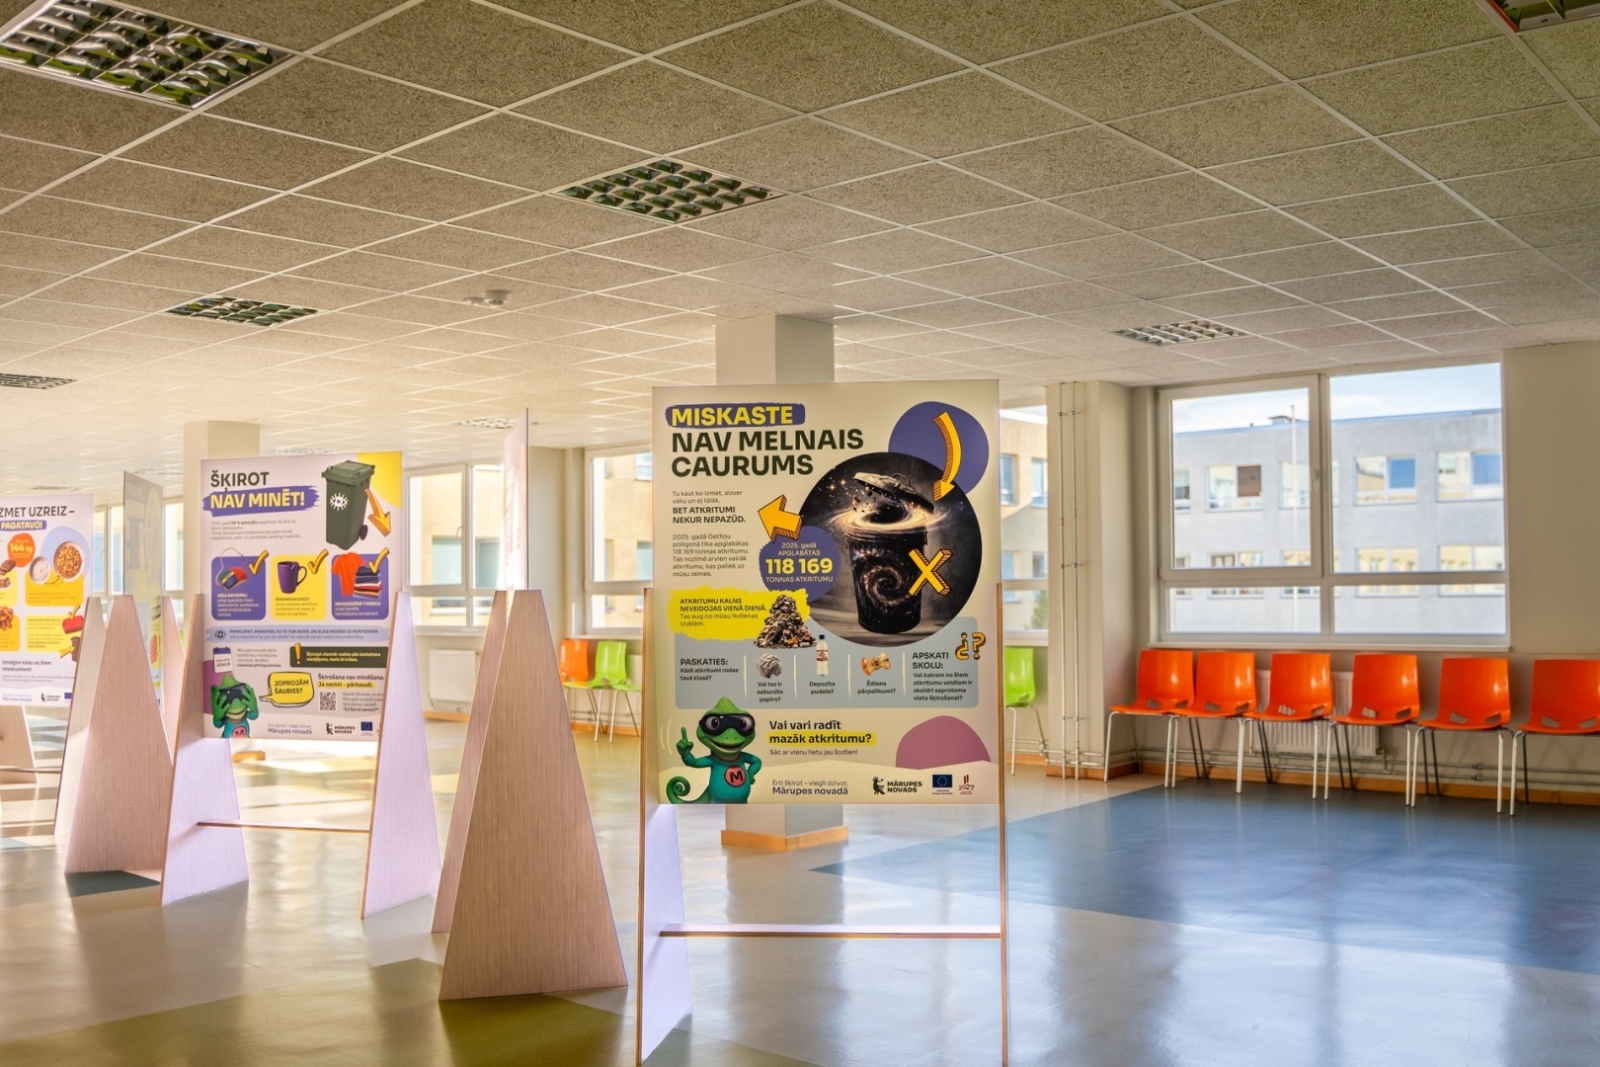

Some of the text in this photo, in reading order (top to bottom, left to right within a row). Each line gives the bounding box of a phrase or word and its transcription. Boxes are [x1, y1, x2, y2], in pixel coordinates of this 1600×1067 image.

[671, 406, 793, 427] MISKASTE
[672, 429, 864, 453] NAV MELNAIS
[671, 454, 814, 477] CAURUMS
[210, 469, 269, 492] ŠĶIROT
[210, 488, 305, 509] NAV MINĒT!
[28, 506, 67, 517] UZREIZ
[704, 514, 746, 523] NEPAZŪD.
[766, 558, 833, 574] 118 169
[769, 720, 841, 730] Vai vari radīt
[769, 733, 872, 743] mazāk atkritumu?
[729, 770, 743, 783] M
[772, 787, 848, 796] Mārupes novadā
